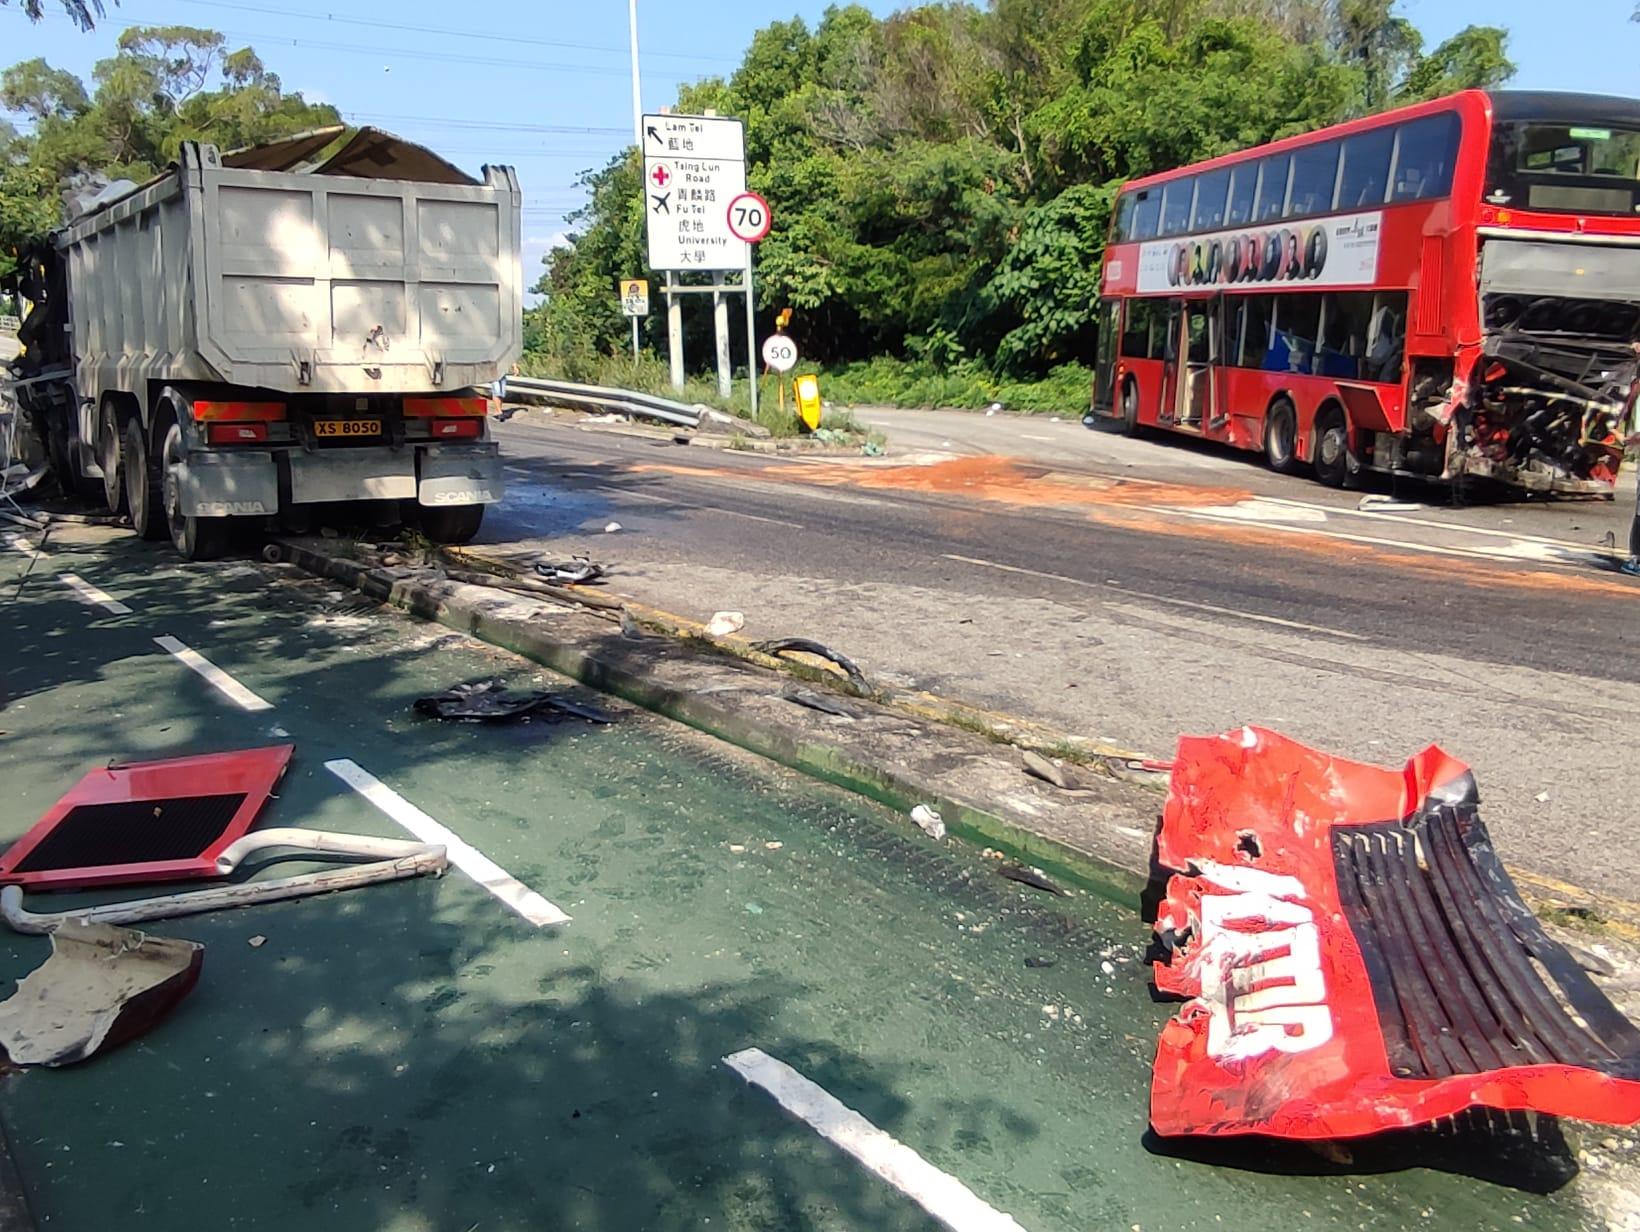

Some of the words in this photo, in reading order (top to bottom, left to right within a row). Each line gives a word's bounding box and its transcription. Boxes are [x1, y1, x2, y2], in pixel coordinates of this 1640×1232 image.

[665, 121, 687, 133] Lam
[690, 122, 704, 133] Tei
[668, 137, 694, 151] 藍地
[674, 161, 700, 173] Tsing
[702, 162, 720, 172] Lun
[685, 173, 710, 183] Road
[676, 204, 689, 214] Fu
[691, 204, 706, 214] Tei
[735, 207, 762, 227] 70
[678, 219, 705, 233] 虎地
[677, 235, 728, 247] University
[680, 250, 706, 264] 大學
[770, 346, 792, 360] 50
[317, 421, 337, 435] XS
[342, 421, 379, 434] 8050
[434, 490, 492, 503] SCANIA
[196, 501, 265, 514] SCANIA
